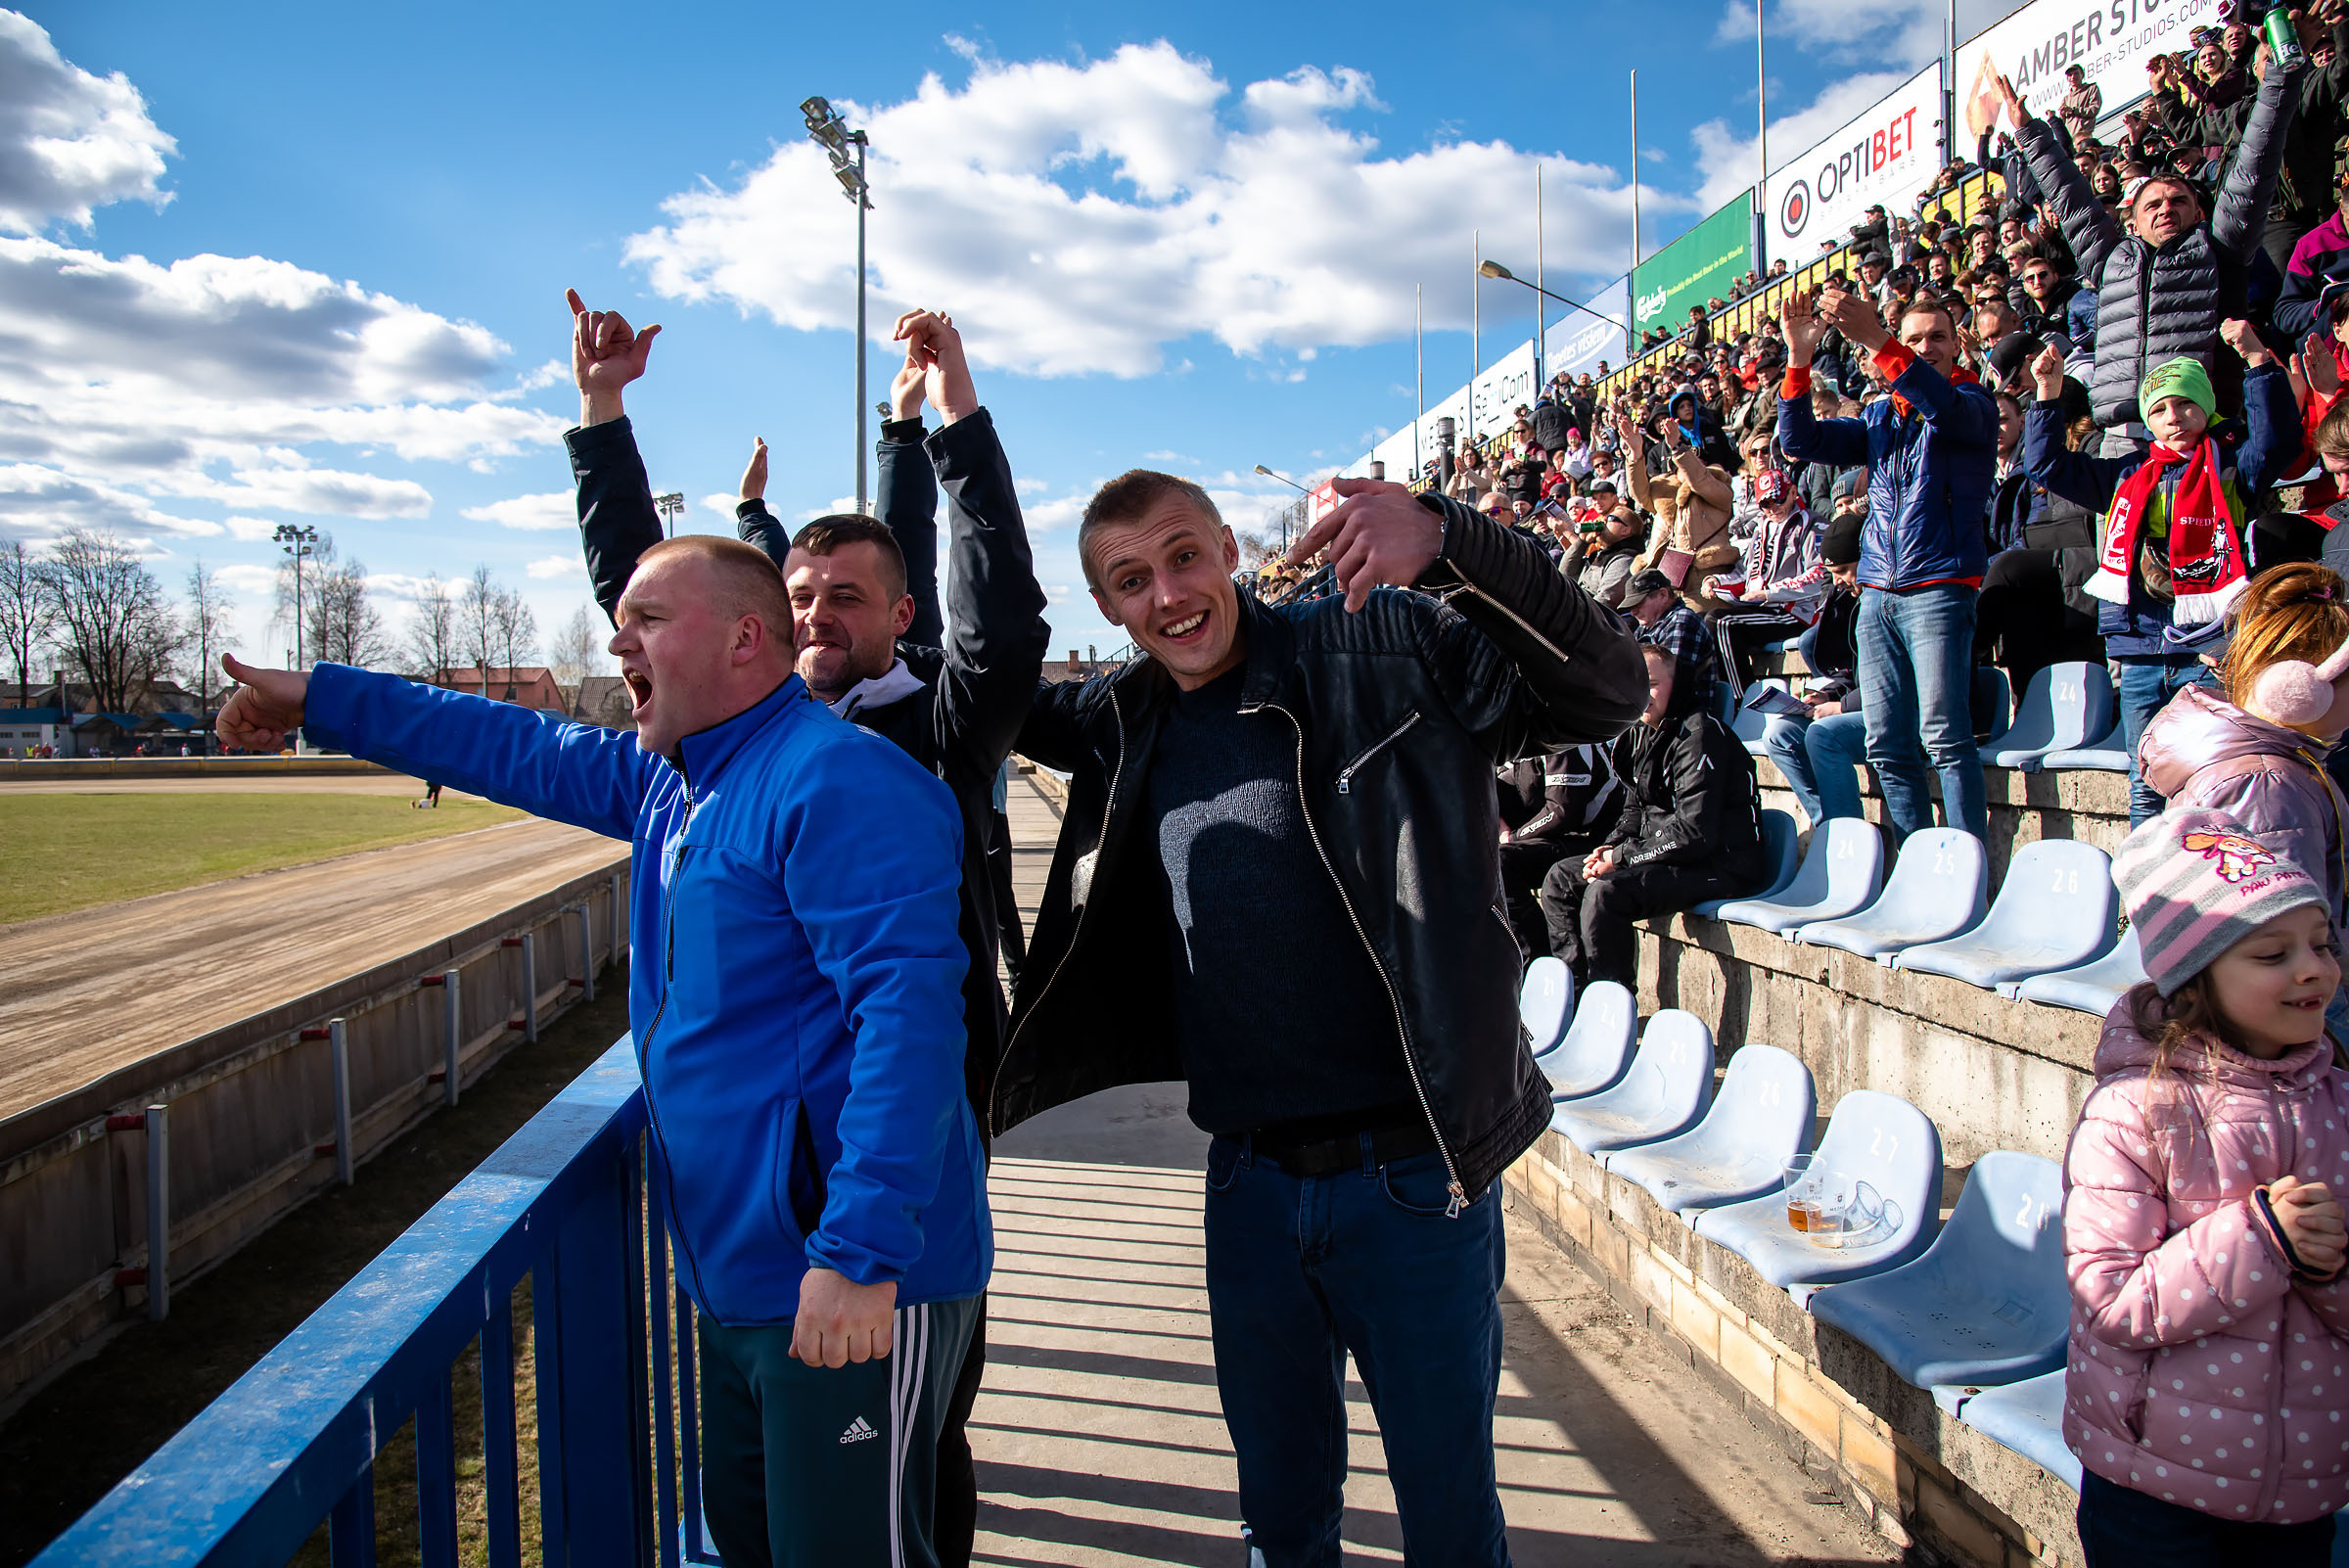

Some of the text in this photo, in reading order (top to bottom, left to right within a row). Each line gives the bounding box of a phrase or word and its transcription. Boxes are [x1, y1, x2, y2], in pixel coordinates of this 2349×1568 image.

[2016, 10, 2102, 93] AMBER
[1818, 106, 1917, 204] OPTIBET
[1635, 285, 1667, 323] Carlsberg
[2180, 516, 2215, 527] SPEED
[1630, 841, 1678, 865] ADRENALINE
[1933, 853, 1955, 875] 25
[2051, 868, 2078, 894] 26
[2239, 877, 2270, 897] PAW
[839, 1428, 879, 1444] adidas
